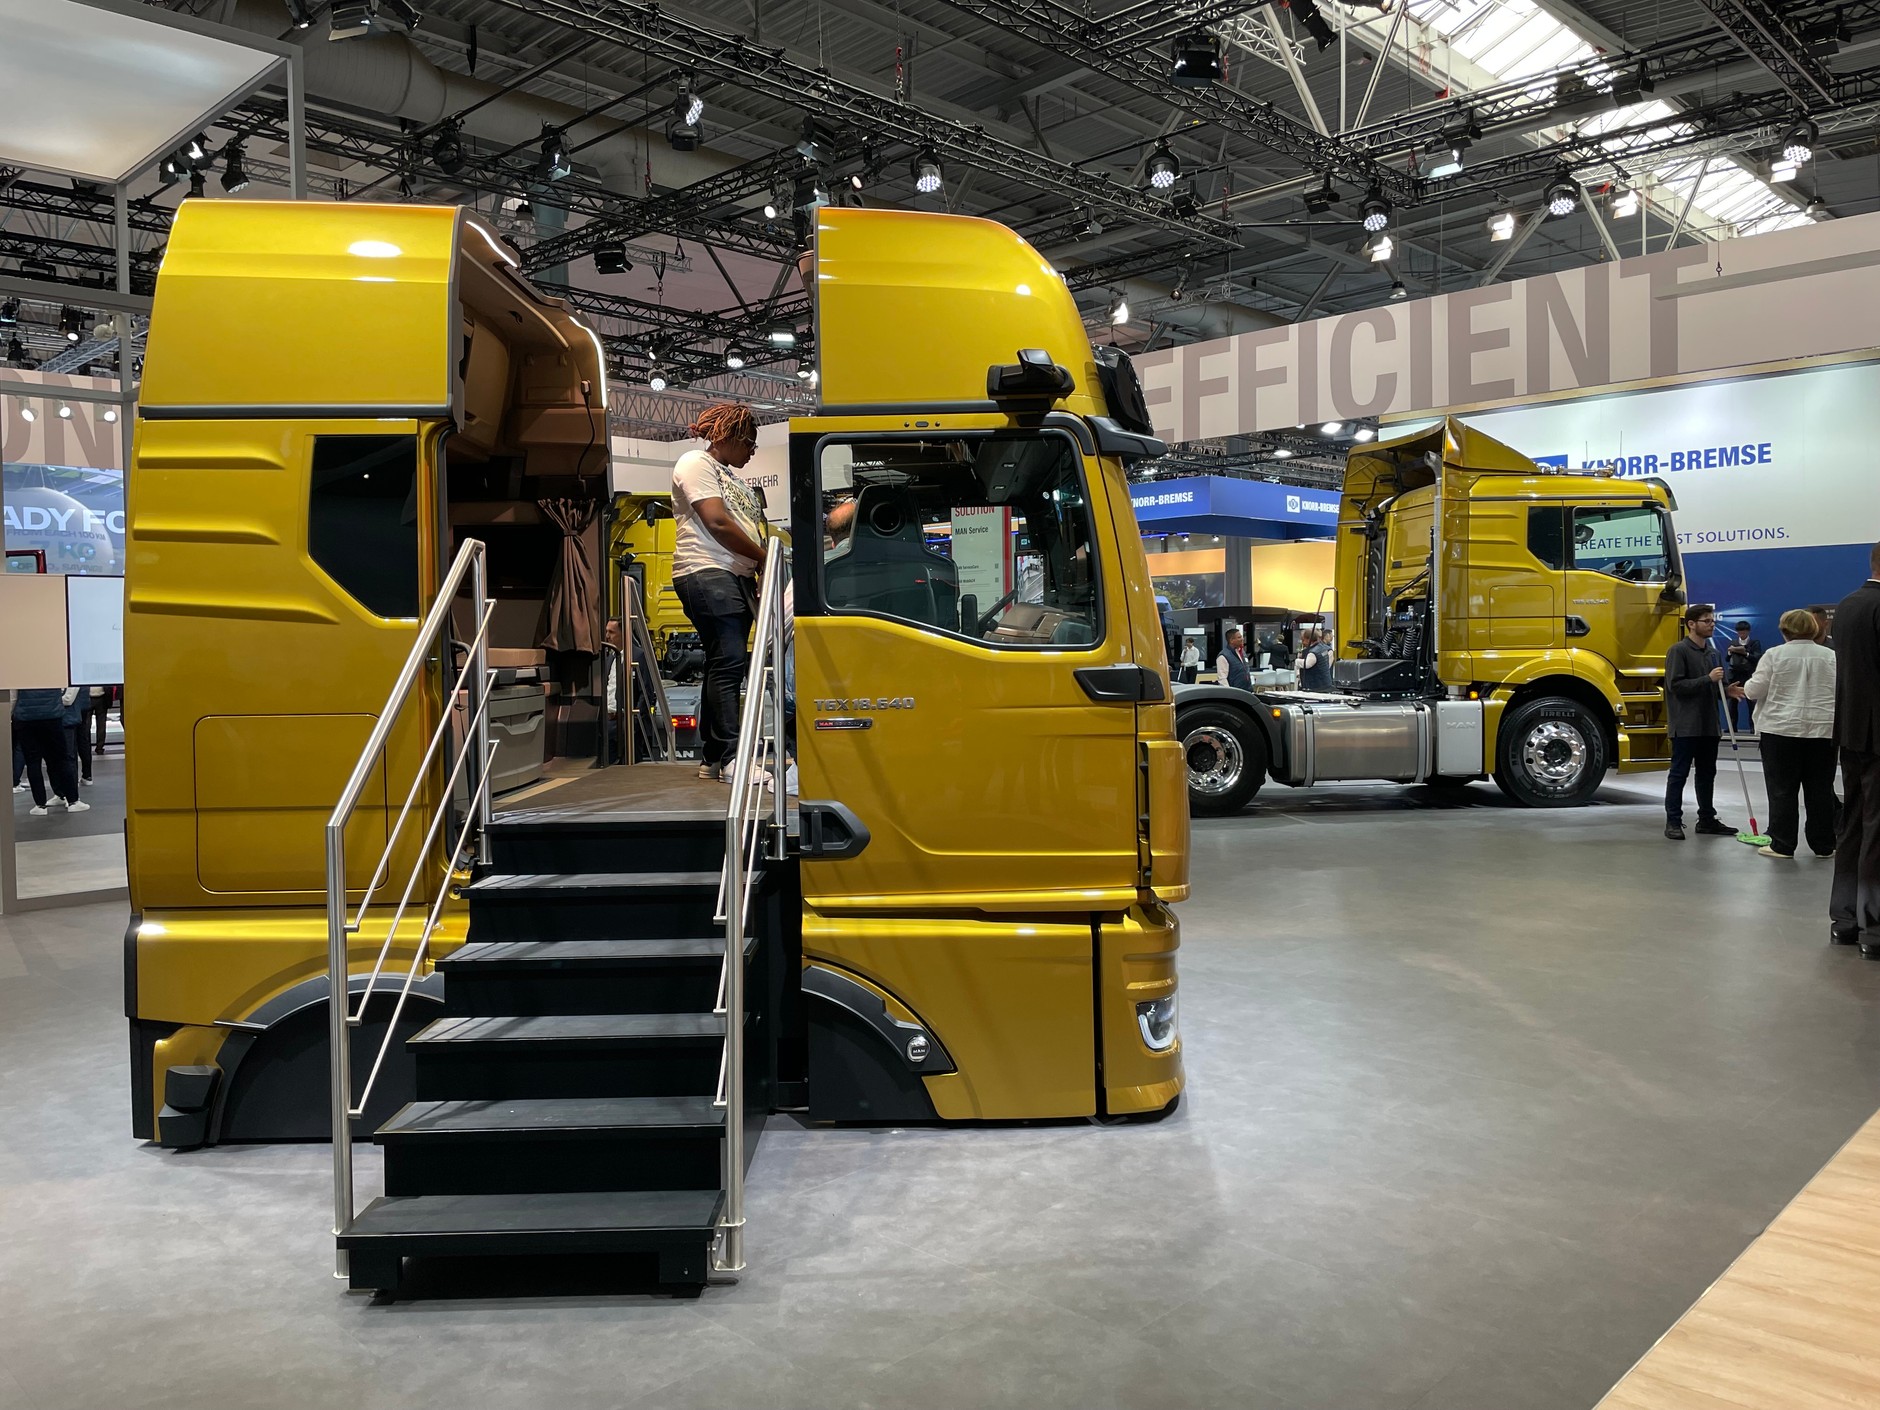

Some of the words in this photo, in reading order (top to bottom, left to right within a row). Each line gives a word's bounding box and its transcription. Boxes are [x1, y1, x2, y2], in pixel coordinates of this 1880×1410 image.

[1131, 243, 1708, 444] EFFICIENT
[745, 474, 779, 488] ERKEHR
[1131, 491, 1194, 508] NORR-BREMSE
[1301, 500, 1340, 514] KNORR-BREMSE
[955, 527, 968, 535] MAN
[969, 526, 989, 534] Service
[1574, 537, 1622, 552] REATE
[1625, 535, 1652, 548] THE
[1696, 527, 1790, 543] SOLUTIONS.
[814, 698, 849, 711] TGX
[852, 697, 915, 711] 18.640
[1540, 707, 1575, 718] PIRELLI
